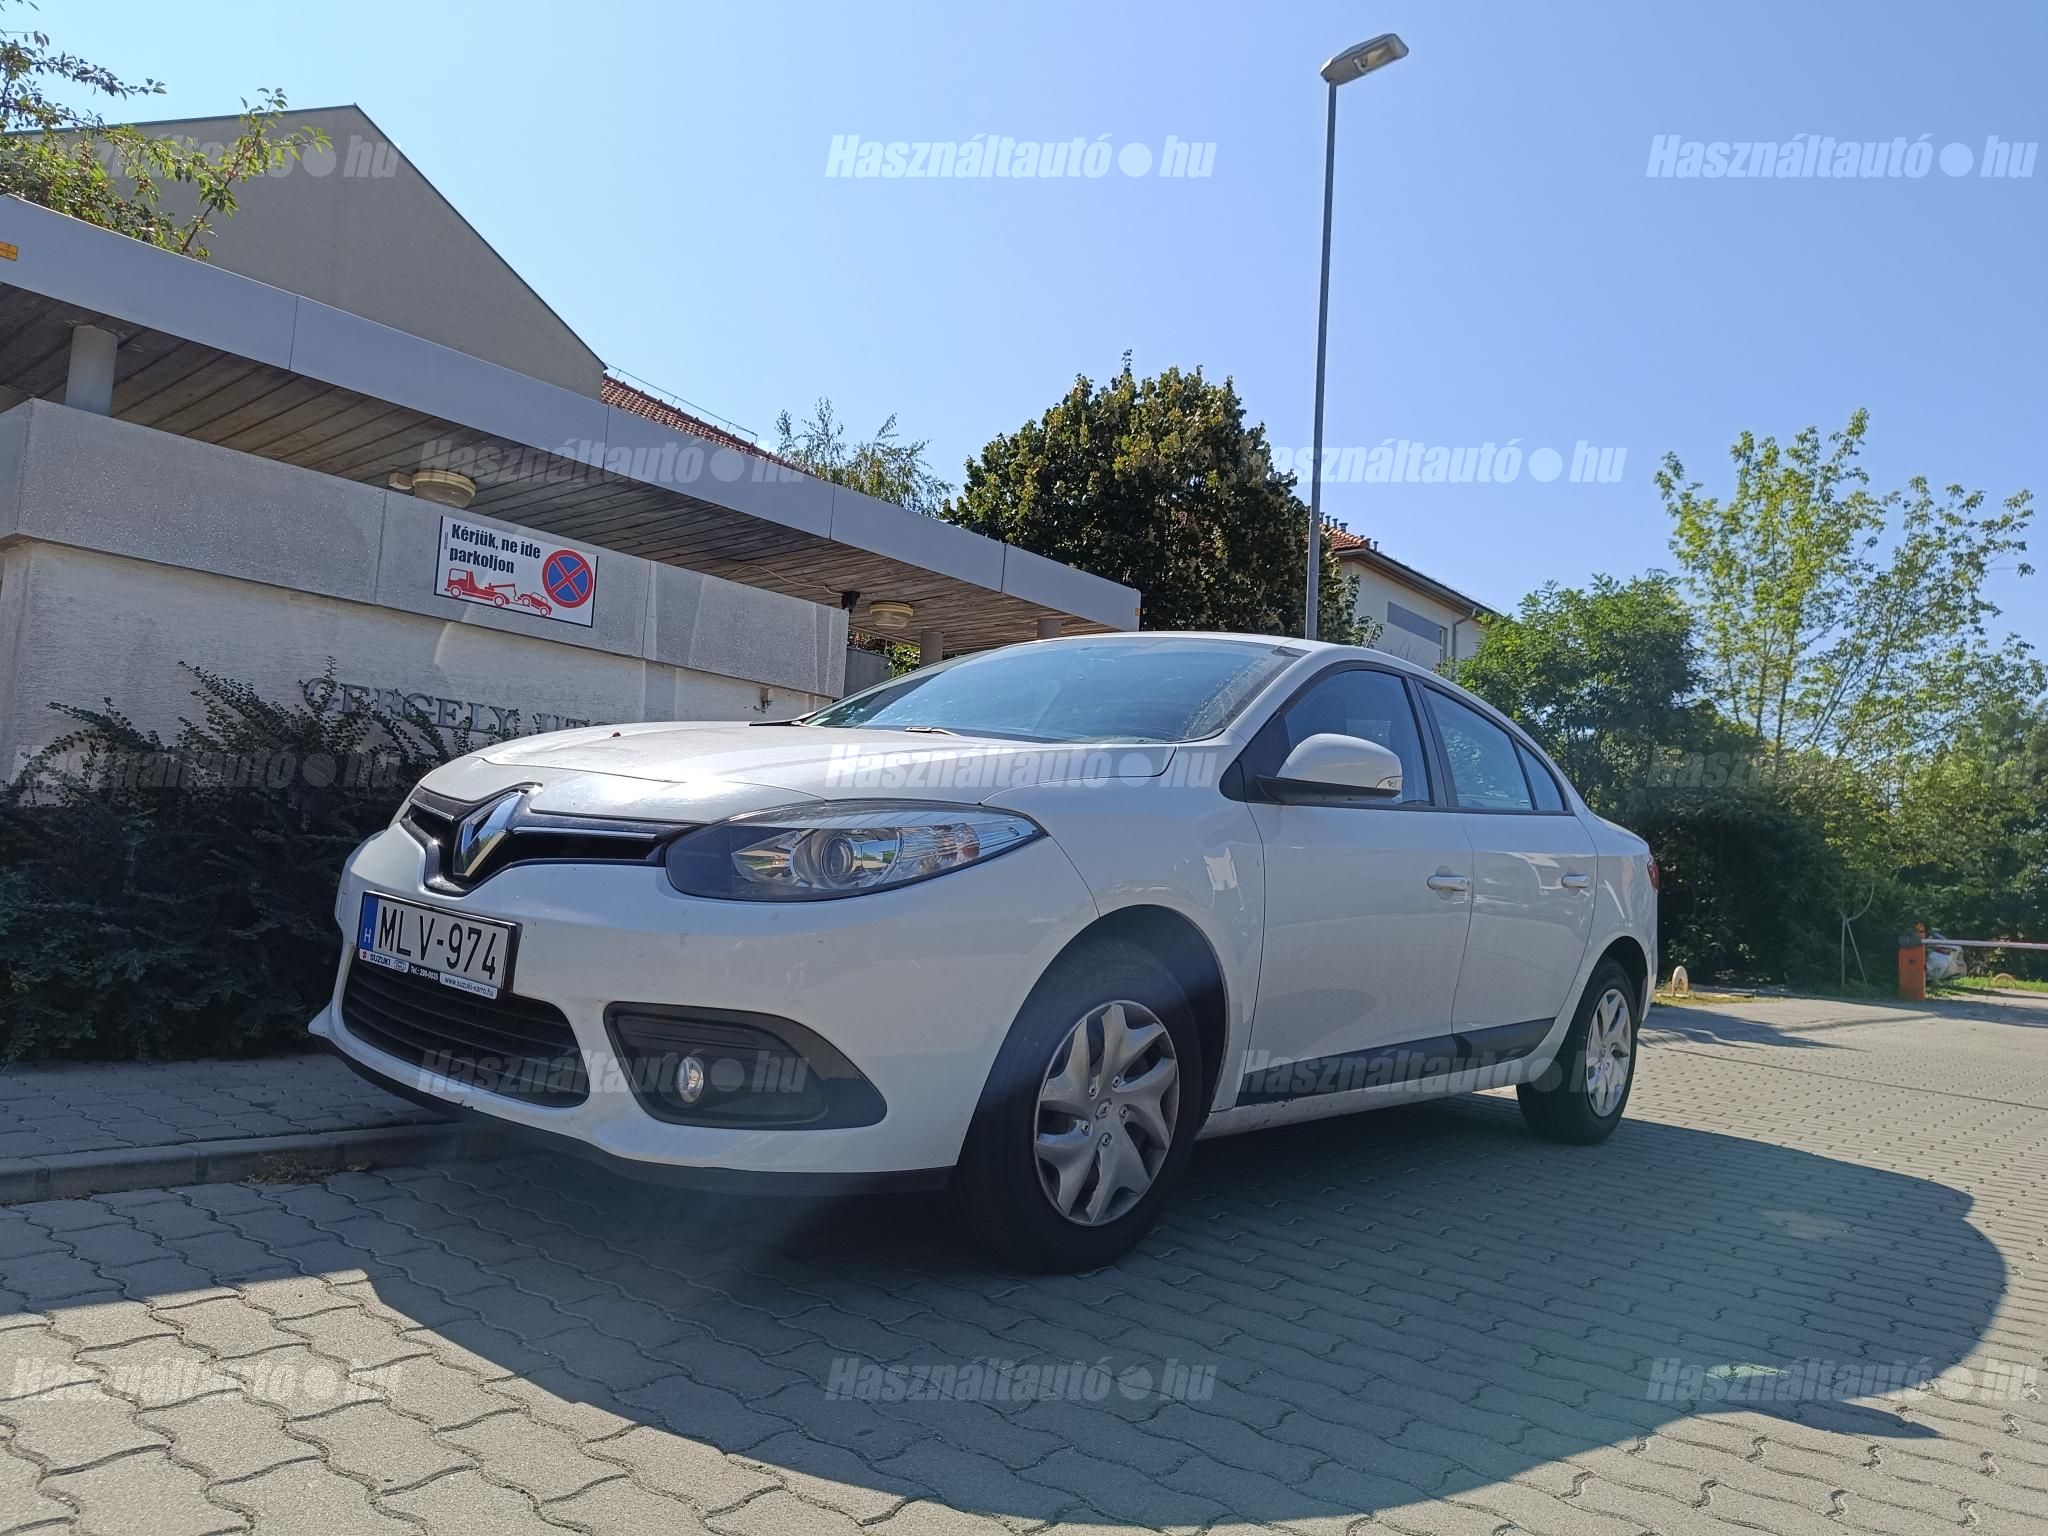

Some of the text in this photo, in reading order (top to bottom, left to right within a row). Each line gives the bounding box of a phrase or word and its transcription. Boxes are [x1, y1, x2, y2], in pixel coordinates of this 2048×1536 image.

[451, 523, 498, 550] Kérjük,
[501, 538, 518, 554] ne
[520, 541, 541, 559] ide
[449, 547, 515, 574] parkoljon
[363, 906, 498, 980] H MLV-974
[370, 953, 391, 966] SUZUKI
